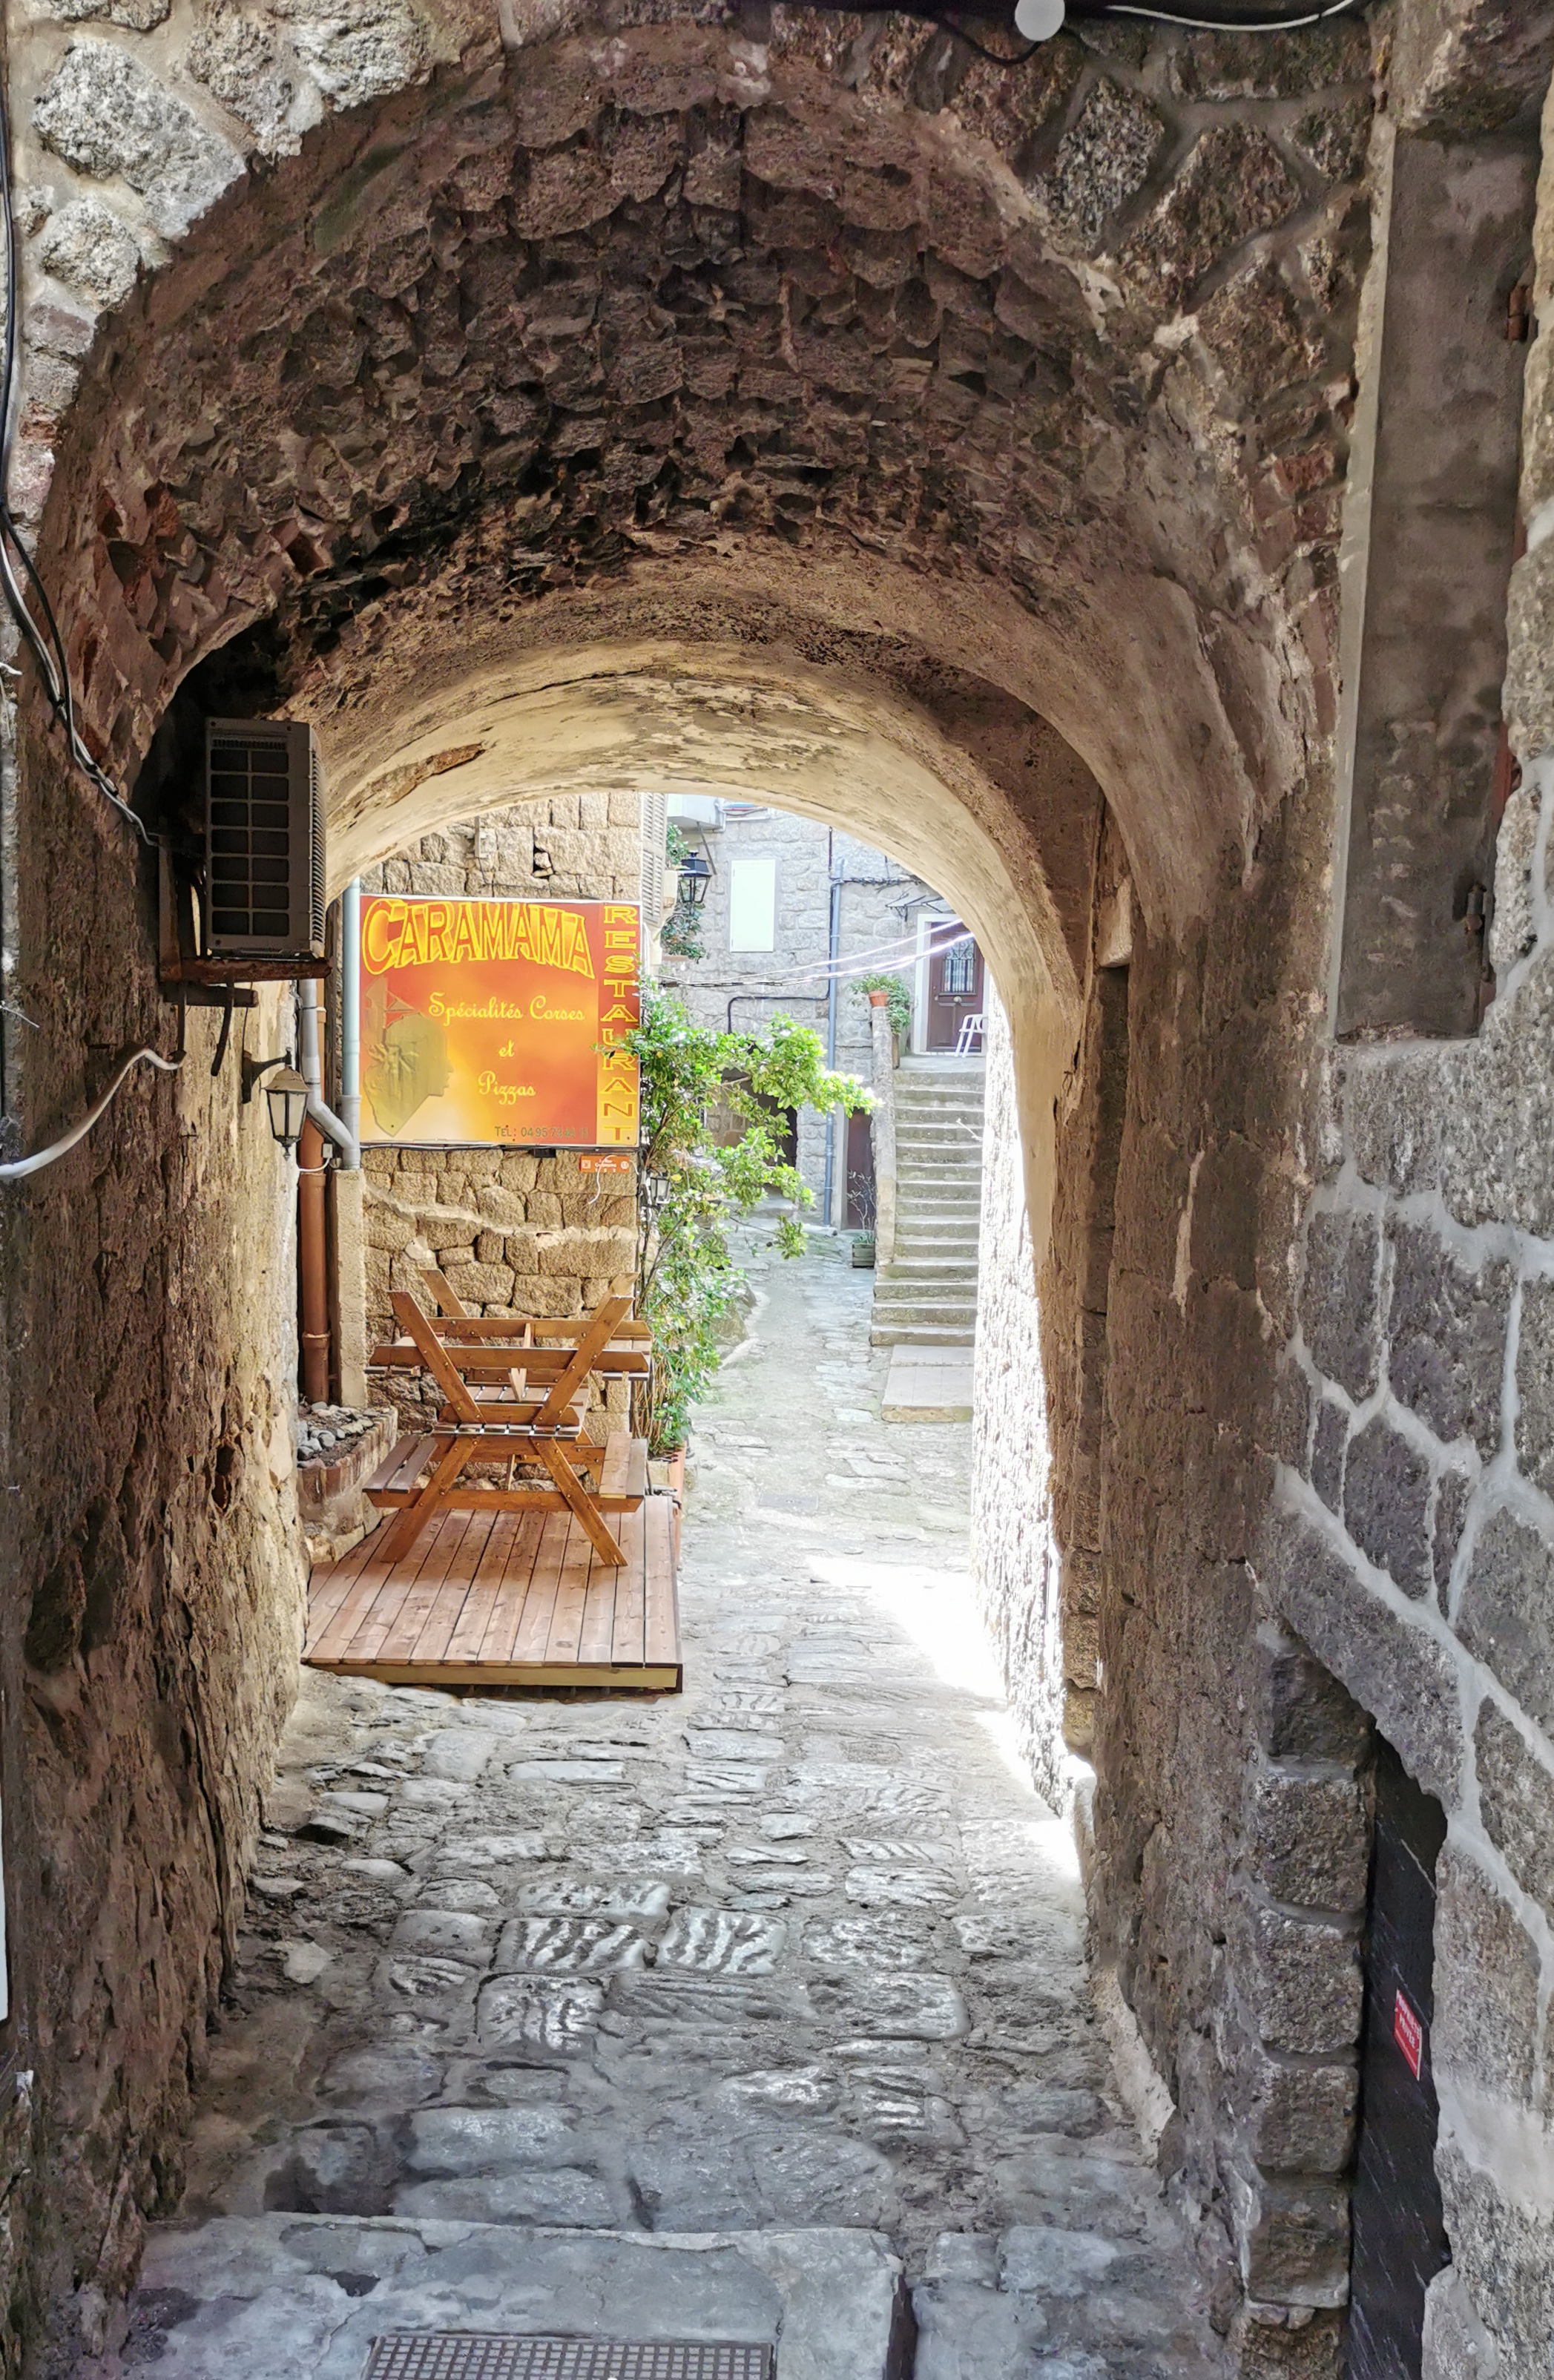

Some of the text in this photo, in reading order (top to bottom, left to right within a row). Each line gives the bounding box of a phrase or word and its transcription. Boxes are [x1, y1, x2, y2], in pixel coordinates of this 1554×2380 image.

[361, 898, 595, 979] CARAMAMA
[428, 992, 585, 1027] Spécialités Corses
[599, 905, 639, 1142] RESTAURANT
[498, 1039, 516, 1057] et
[478, 1071, 536, 1105] Pizzas
[521, 1126, 533, 1137] 04
[535, 1126, 548, 1137] 95
